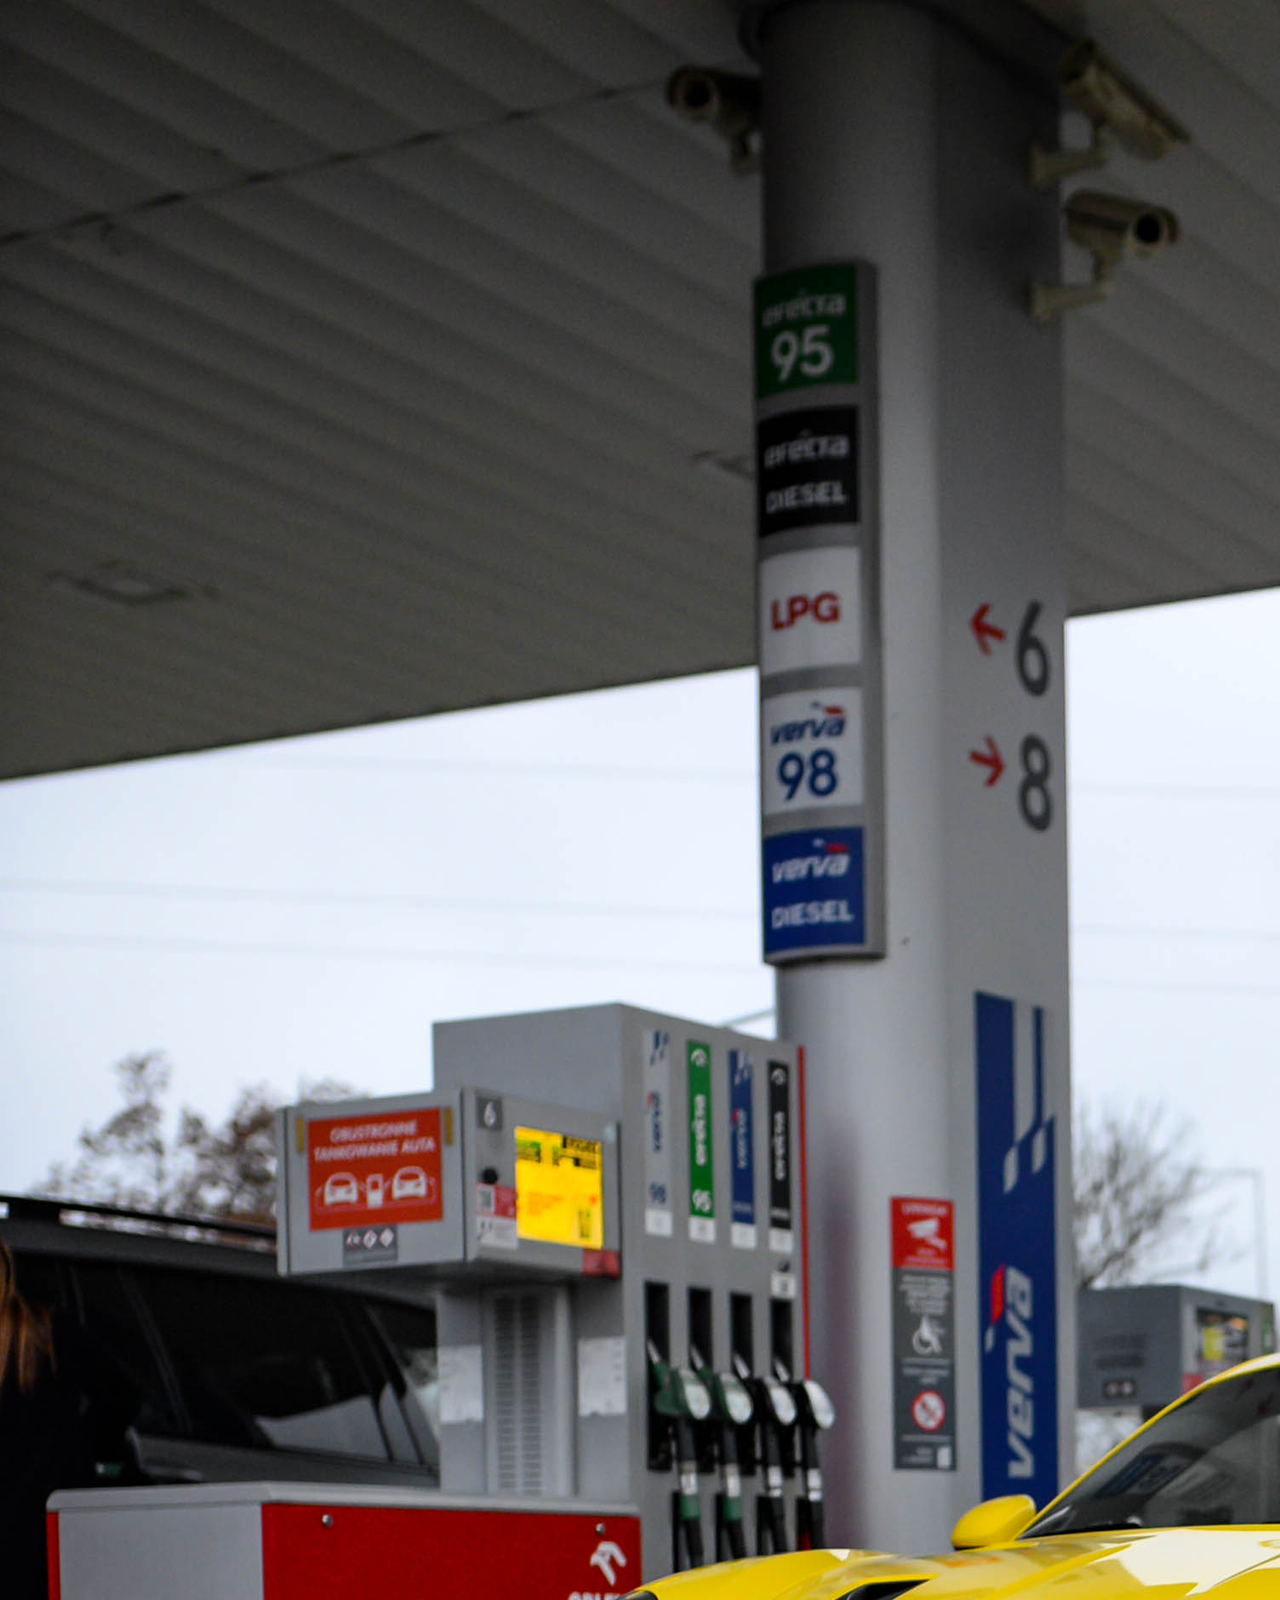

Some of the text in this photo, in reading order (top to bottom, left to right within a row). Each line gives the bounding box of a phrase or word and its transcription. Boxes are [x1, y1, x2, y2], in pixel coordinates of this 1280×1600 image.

[771, 324, 834, 382] 95
[765, 480, 848, 514] DIESEL
[771, 592, 841, 631] LPG
[1015, 599, 1051, 697] 6
[771, 714, 846, 746] verva
[777, 748, 838, 801] 98
[1018, 732, 1054, 832] 8
[771, 852, 850, 884] verva
[771, 899, 854, 929] DIESEL
[330, 1120, 418, 1143] OBUSTRONNE
[314, 1136, 436, 1162] TANKOWANIE AUTA
[692, 1189, 712, 1213] 95
[1006, 1265, 1035, 1480] verva
